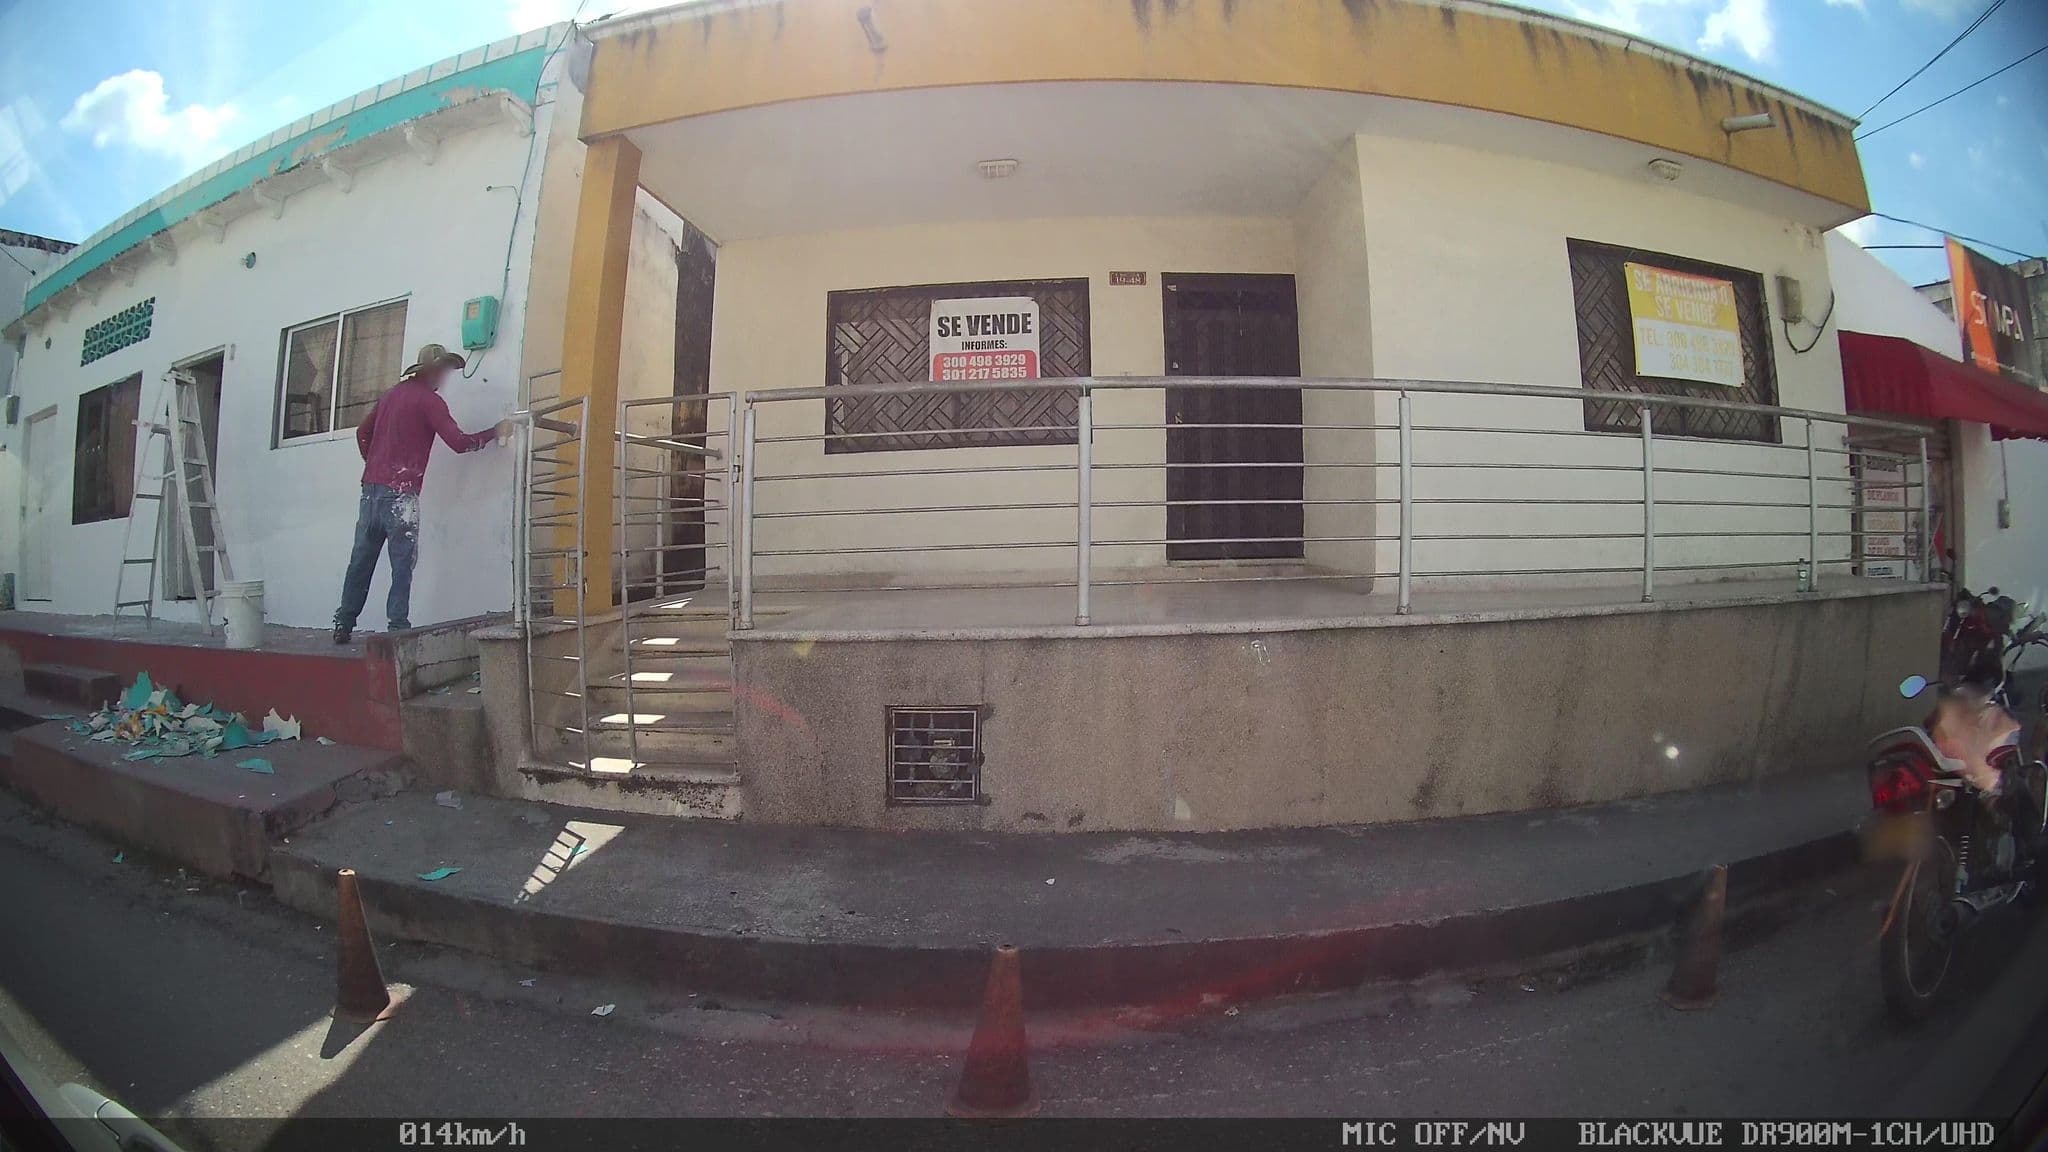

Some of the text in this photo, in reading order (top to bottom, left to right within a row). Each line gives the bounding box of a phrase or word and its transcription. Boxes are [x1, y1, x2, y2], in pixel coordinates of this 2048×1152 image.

[1634, 268, 1653, 292] SE
[1655, 295, 1673, 319] SE
[1970, 290, 2025, 342] STMPA
[937, 312, 1032, 338] SE VENDE
[961, 340, 1008, 351] INFORMES:
[943, 353, 1026, 368] 300 498 3929
[942, 366, 1027, 380] 301 217 5835
